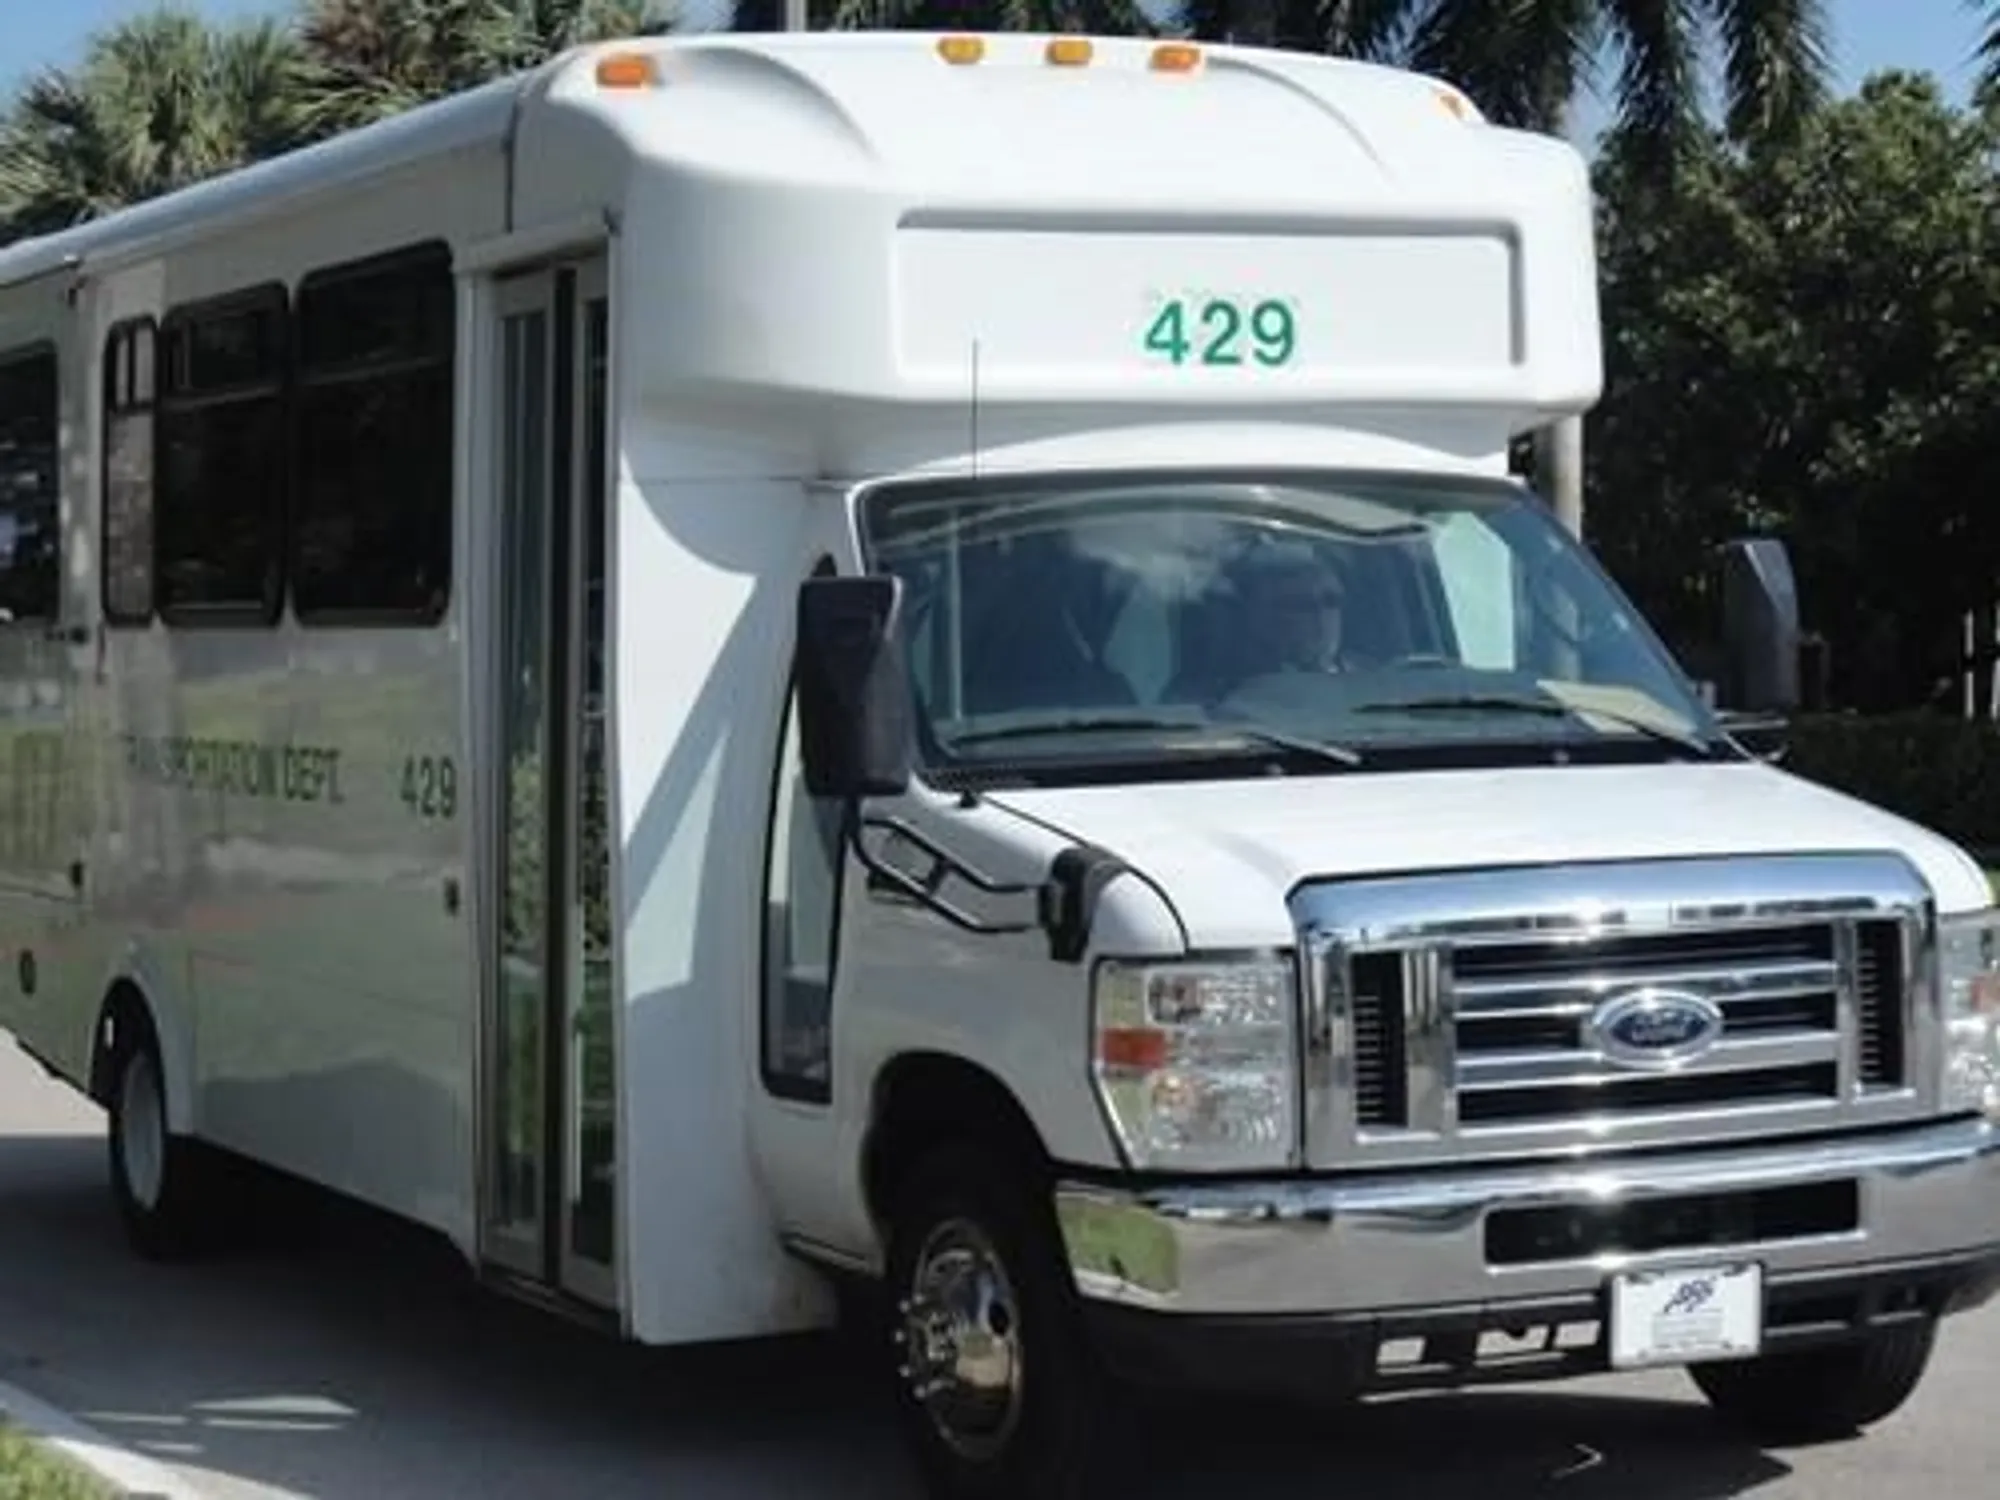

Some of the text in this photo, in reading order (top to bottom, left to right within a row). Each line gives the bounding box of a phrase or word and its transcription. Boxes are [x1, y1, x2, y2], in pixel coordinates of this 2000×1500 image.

[1145, 299, 1294, 366] 429
[117, 735, 277, 797] SPORTATION
[400, 755, 457, 819] 429
